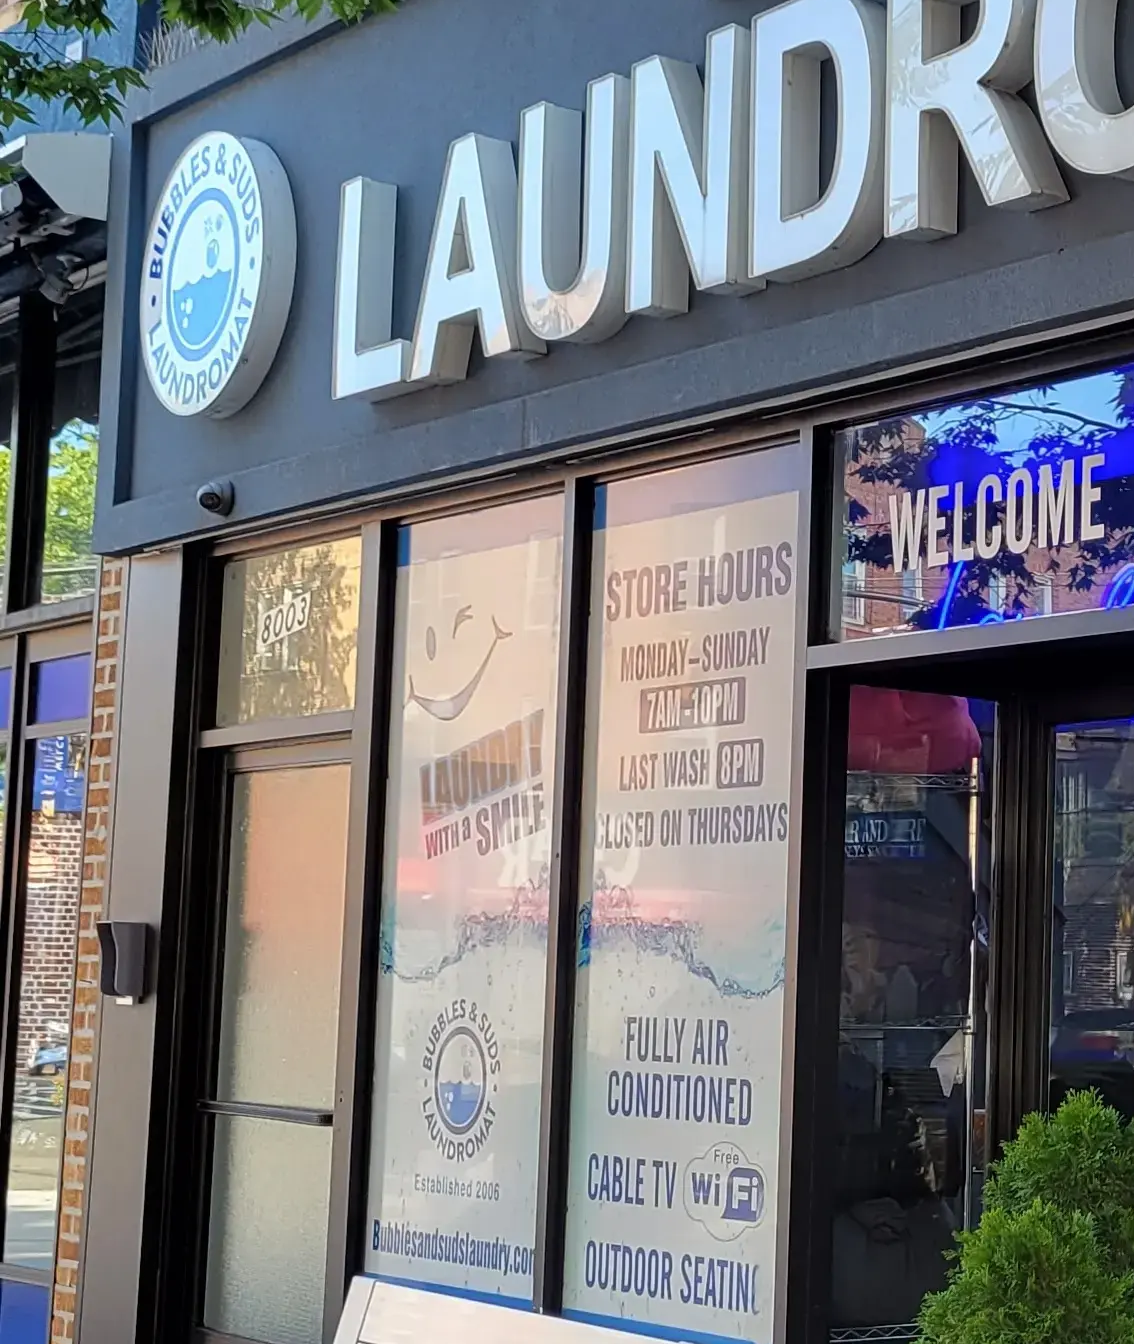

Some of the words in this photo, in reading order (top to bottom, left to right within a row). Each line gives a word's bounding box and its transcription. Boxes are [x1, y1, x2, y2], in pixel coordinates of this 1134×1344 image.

[150, 145, 210, 280] BUBBLES
[215, 143, 226, 176] &
[228, 153, 260, 244] SUDS
[148, 288, 253, 405] LAUNDROMAT
[888, 453, 1105, 574] WELCOME
[606, 560, 688, 622] STORE
[697, 541, 793, 608] HOURS
[261, 596, 308, 644] 8003
[619, 753, 658, 792] LAST
[663, 748, 711, 789] WASH
[720, 742, 761, 785] 8PM
[425, 821, 460, 859] WITH
[462, 816, 471, 842] a
[475, 783, 546, 856] SMILE
[596, 811, 655, 849] CLOSED
[660, 808, 683, 846] ON
[688, 802, 789, 845] THURSDAYS
[423, 998, 467, 1071] BUBBLES
[468, 1002, 478, 1023] &
[478, 1012, 501, 1072] SUDS
[625, 1016, 686, 1064] FULLY
[692, 1019, 729, 1066] AIR
[607, 1070, 752, 1126] CONDITIONED
[422, 1096, 497, 1163] LAUNDROMAT
[713, 1149, 739, 1165] Free
[414, 1173, 473, 1198] Established
[475, 1182, 500, 1201] 2006
[587, 1152, 645, 1206] CABLE
[653, 1160, 677, 1209] TV
[585, 1240, 673, 1301] OUTDOOR
